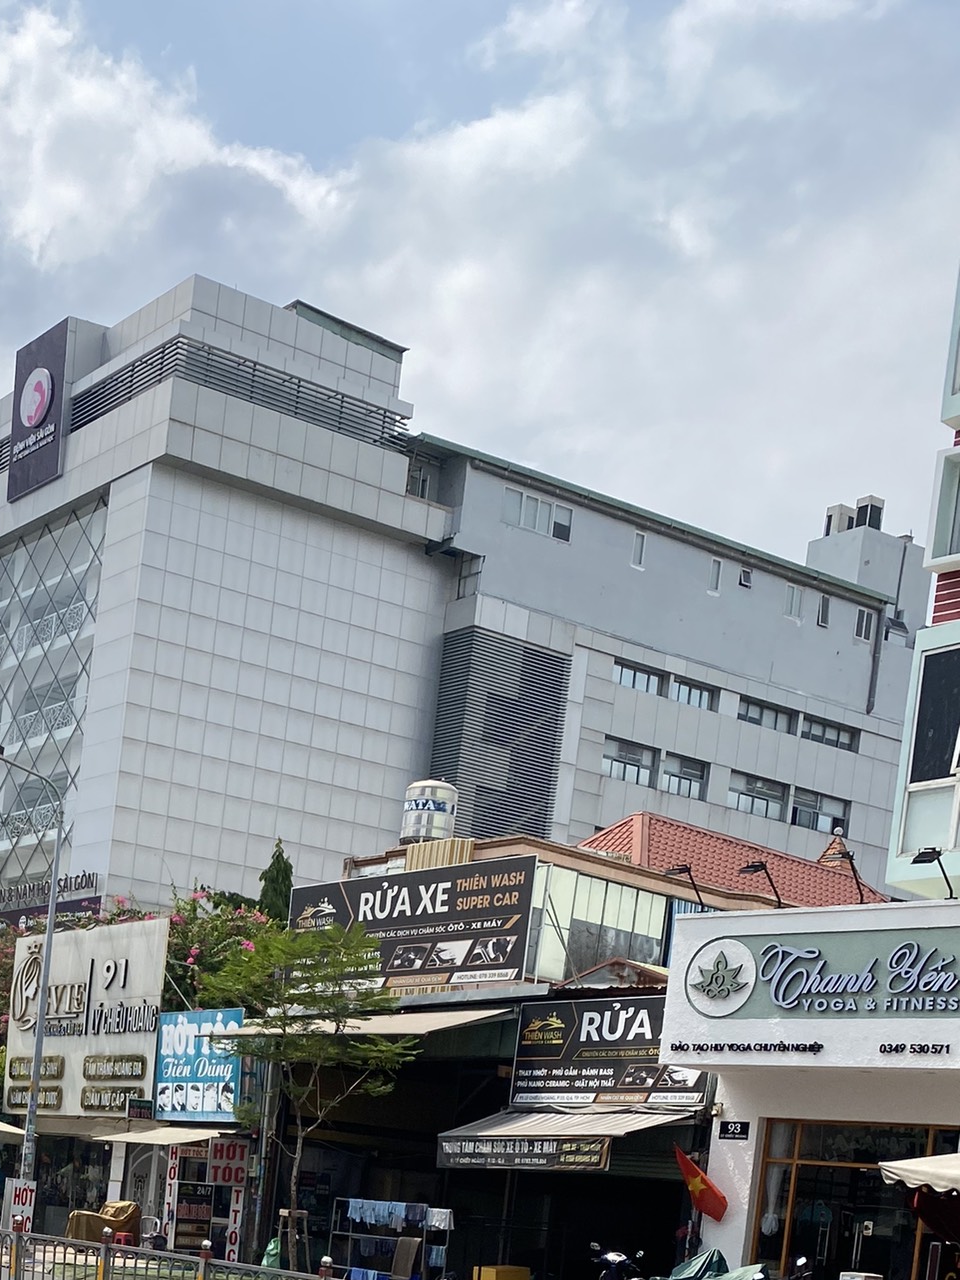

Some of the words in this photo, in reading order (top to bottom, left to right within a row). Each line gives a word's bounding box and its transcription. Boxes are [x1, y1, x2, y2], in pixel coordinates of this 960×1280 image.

[74, 870, 94, 890] GÒN
[456, 874, 488, 892] THIÊN
[491, 871, 525, 889] WASH
[358, 882, 412, 921] RỬA
[416, 882, 452, 916] XE
[456, 896, 490, 911] SUPER
[493, 892, 519, 907] CAR
[470, 922, 482, 930] XE
[483, 919, 503, 929] MÁY
[103, 959, 129, 990] 91
[760, 942, 879, 1008] Thanh
[802, 998, 857, 1012] YOGA
[865, 998, 876, 1012] &
[884, 997, 960, 1012] FITNESS
[92, 1002, 105, 1035] LÝ
[579, 1003, 653, 1042] RỬA
[160, 1014, 199, 1055] HỚT
[543, 1031, 563, 1040] WASH
[671, 1041, 689, 1052] ĐÀO
[692, 1043, 709, 1054] TẠO
[727, 1043, 752, 1052] YOGA
[879, 1044, 906, 1054] 0349
[909, 1043, 930, 1054] 530
[930, 1043, 950, 1054] 571
[162, 1057, 192, 1078] Tiến
[194, 1057, 234, 1081] Dũng
[545, 1080, 570, 1088] CERAMIC
[728, 1123, 741, 1133] 93
[213, 1140, 247, 1161] HỚT
[506, 1142, 514, 1153] XE
[533, 1141, 542, 1153] XE
[211, 1163, 245, 1184] TÓC
[13, 1182, 35, 1207] HỚT
[197, 1186, 212, 1196] 24/7
